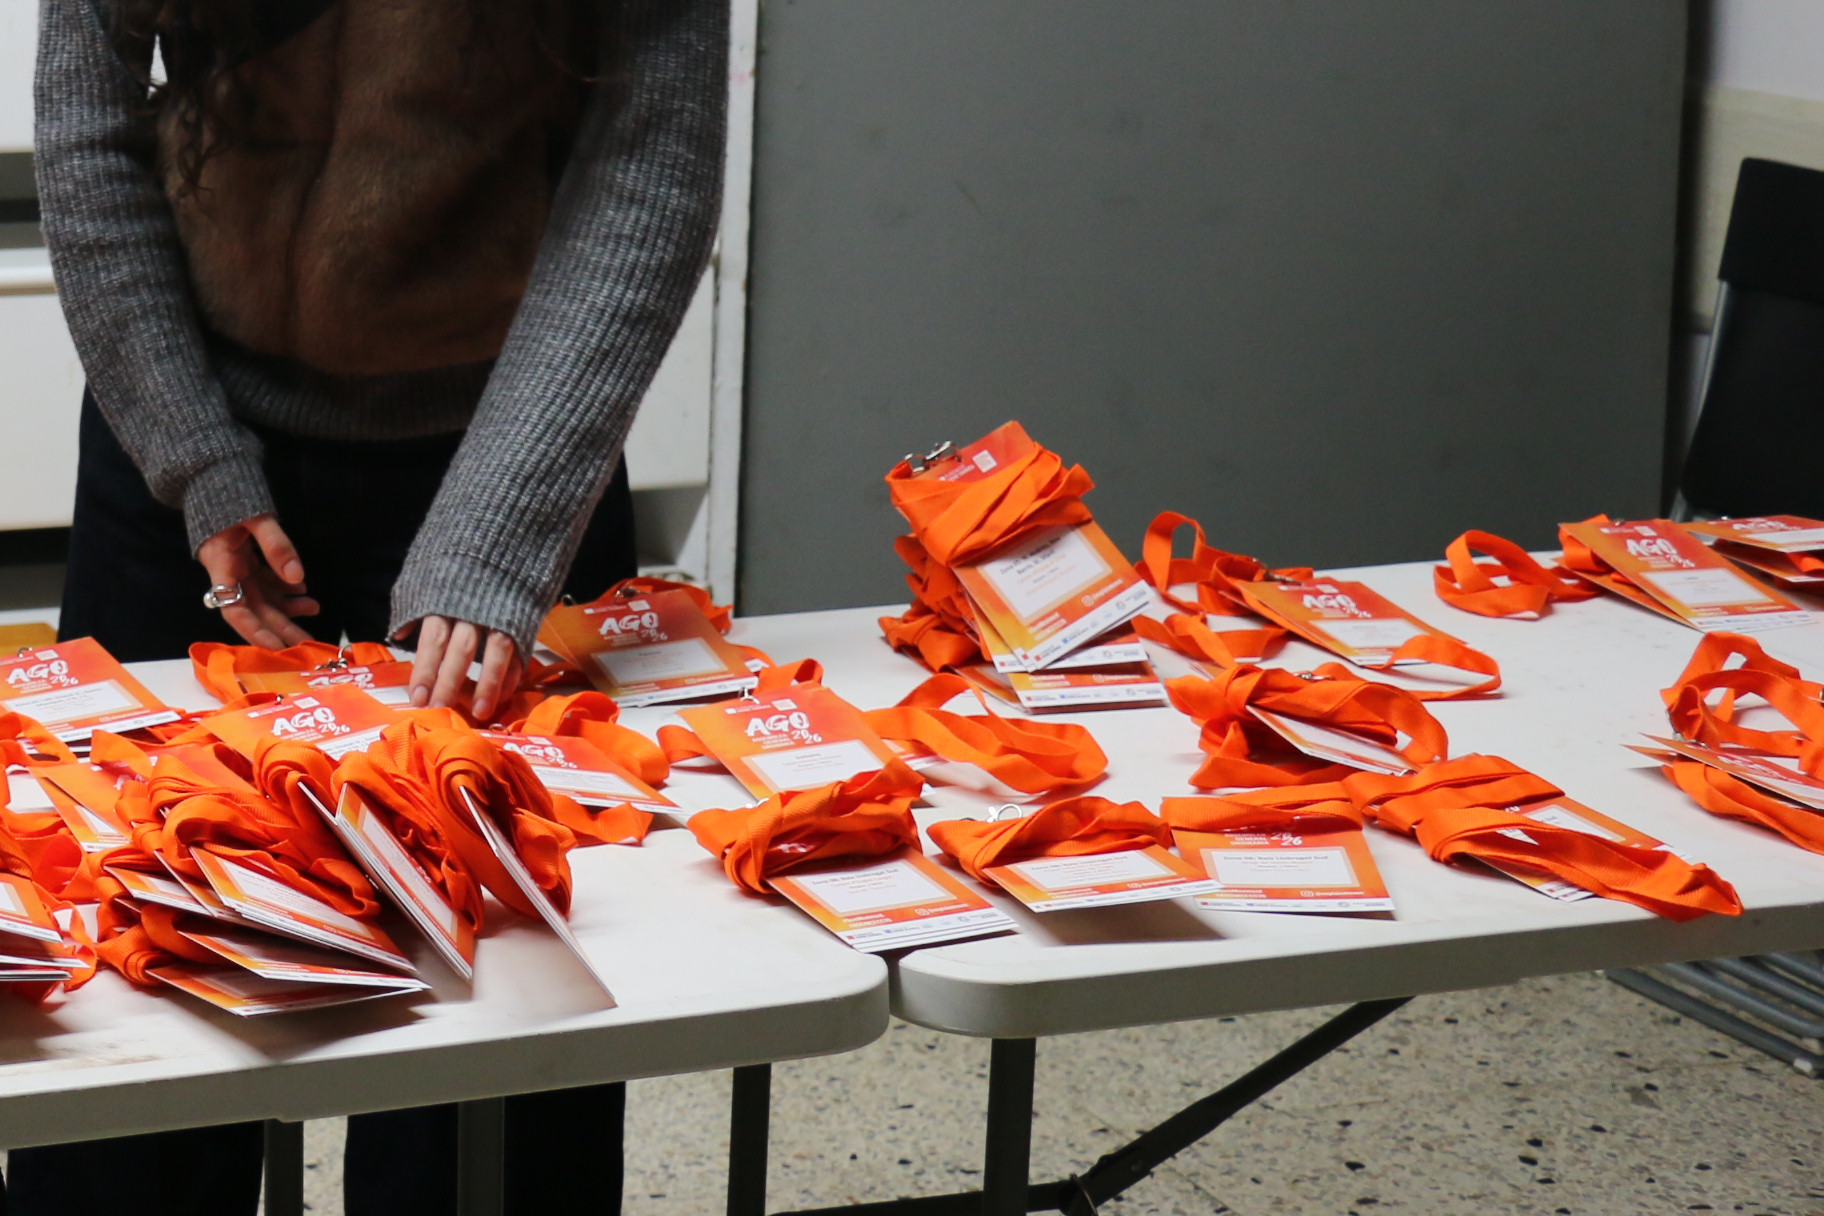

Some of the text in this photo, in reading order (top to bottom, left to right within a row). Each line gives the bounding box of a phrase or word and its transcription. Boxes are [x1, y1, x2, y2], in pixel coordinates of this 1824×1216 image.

[1626, 539, 1678, 556] AGO
[599, 612, 659, 634] AGO
[6, 660, 69, 684] AGO
[271, 707, 336, 736] AGO
[744, 711, 810, 737] AGO
